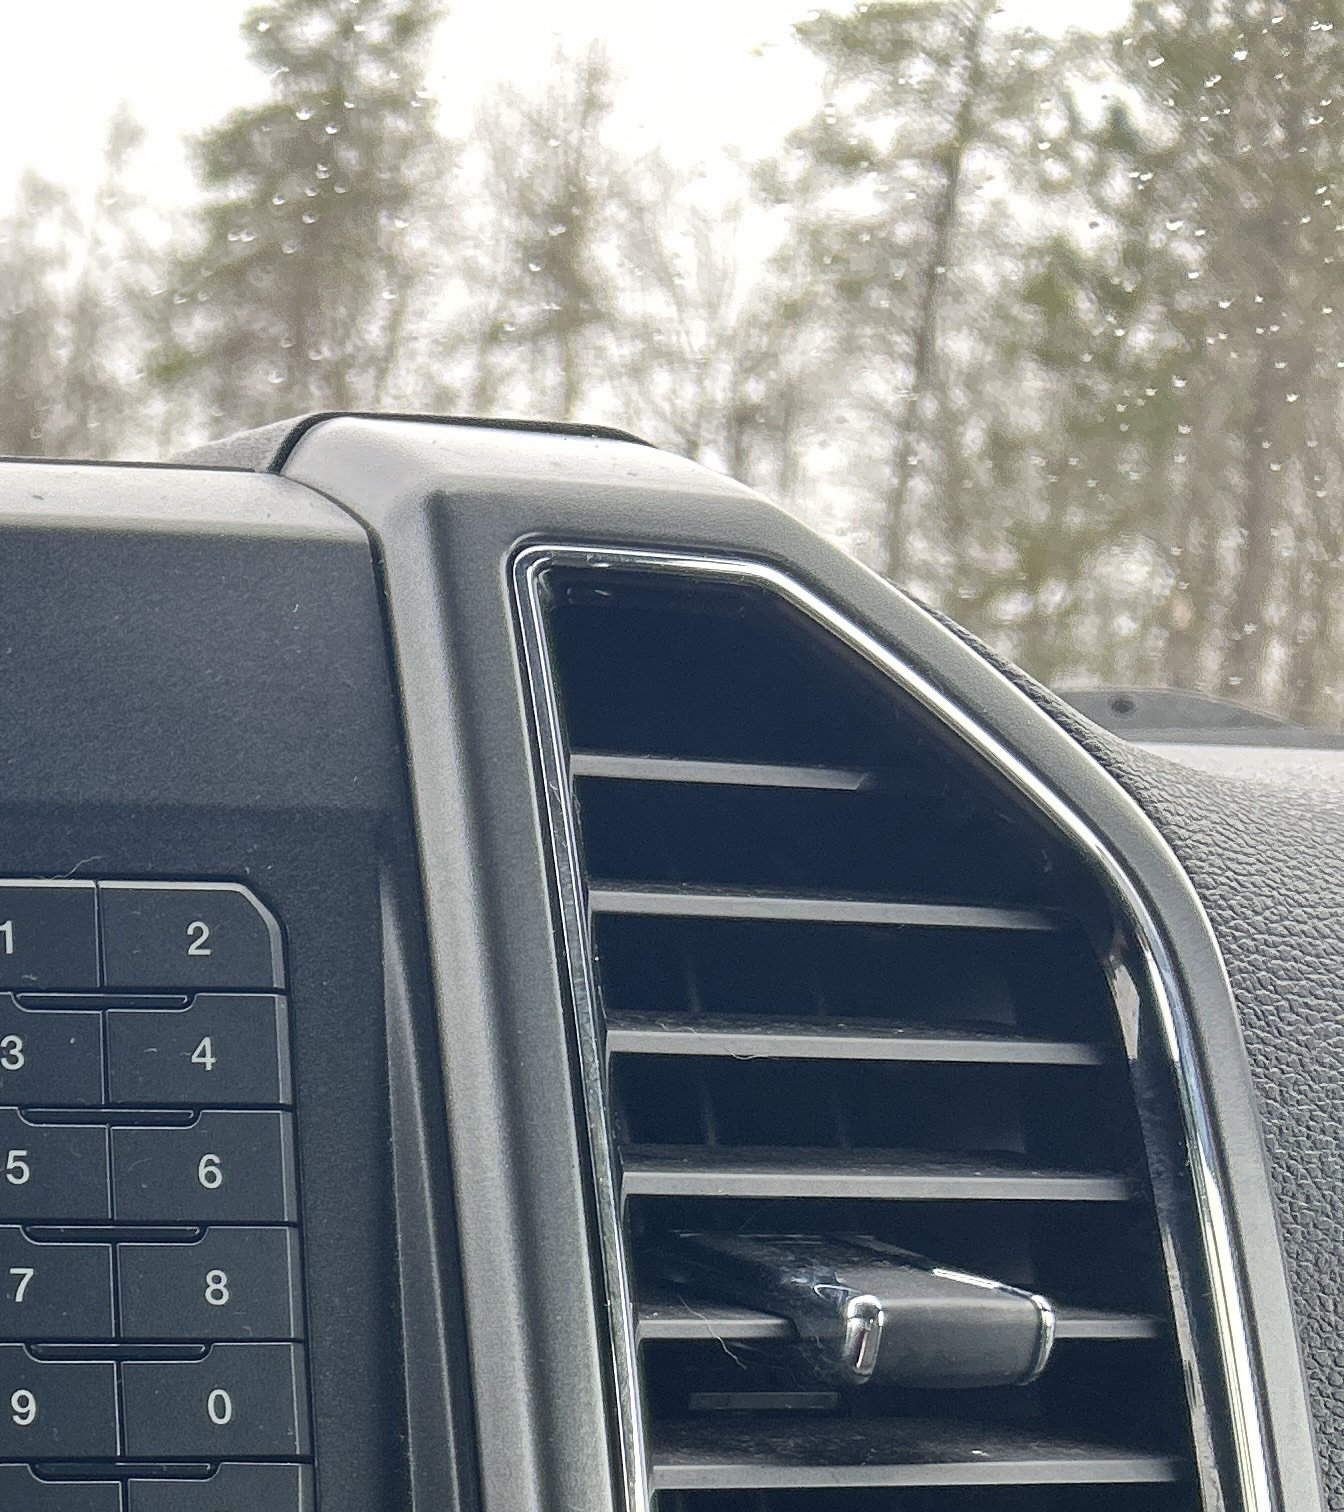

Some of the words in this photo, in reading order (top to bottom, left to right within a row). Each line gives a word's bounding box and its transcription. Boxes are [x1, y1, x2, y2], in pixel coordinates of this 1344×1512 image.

[186, 921, 212, 956] 2
[0, 1034, 25, 1070] 3
[191, 1036, 216, 1071] 4
[6, 1149, 30, 1185] 5
[198, 1153, 223, 1189] 6
[9, 1267, 35, 1303] 7
[204, 1269, 230, 1306] 8
[10, 1389, 37, 1426] 9
[207, 1388, 232, 1425] 0
